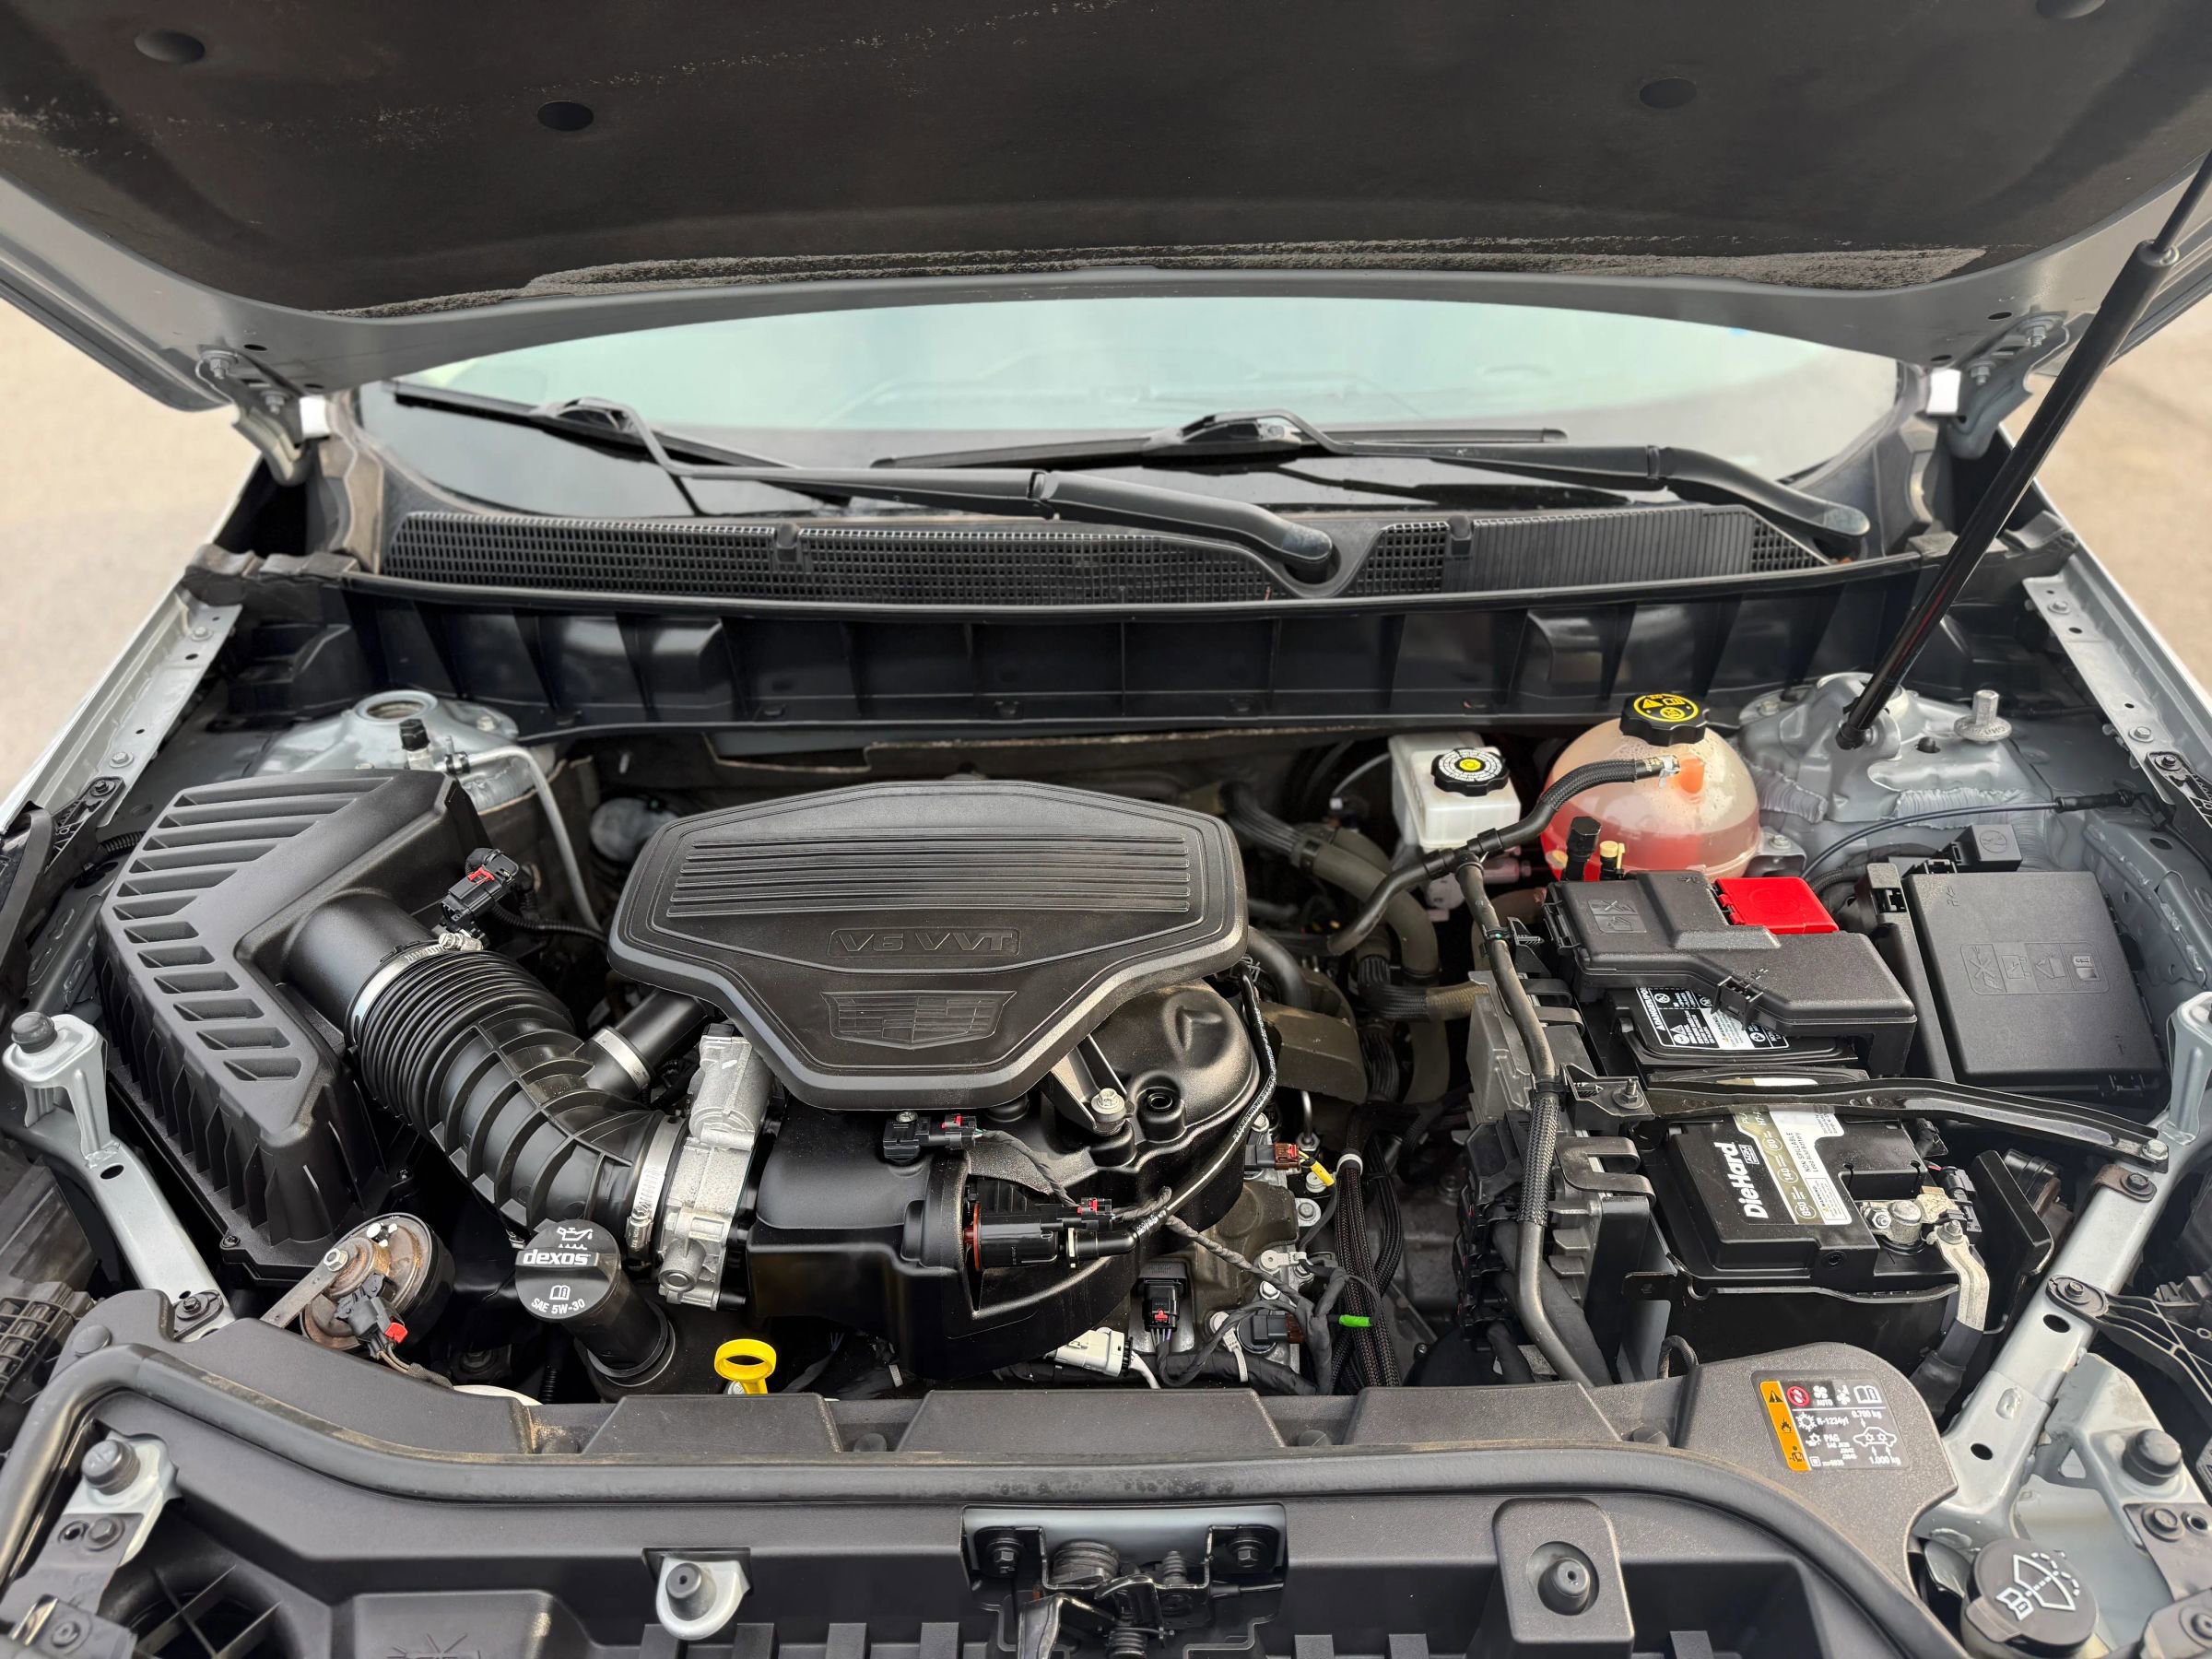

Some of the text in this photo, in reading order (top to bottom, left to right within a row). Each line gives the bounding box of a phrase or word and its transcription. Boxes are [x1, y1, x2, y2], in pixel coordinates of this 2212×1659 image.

[838, 932, 1013, 952] V6 VVT
[1713, 1141, 1769, 1219] DieHard
[523, 1249, 589, 1265] dexos
[531, 1298, 585, 1314] SAE 5W-30
